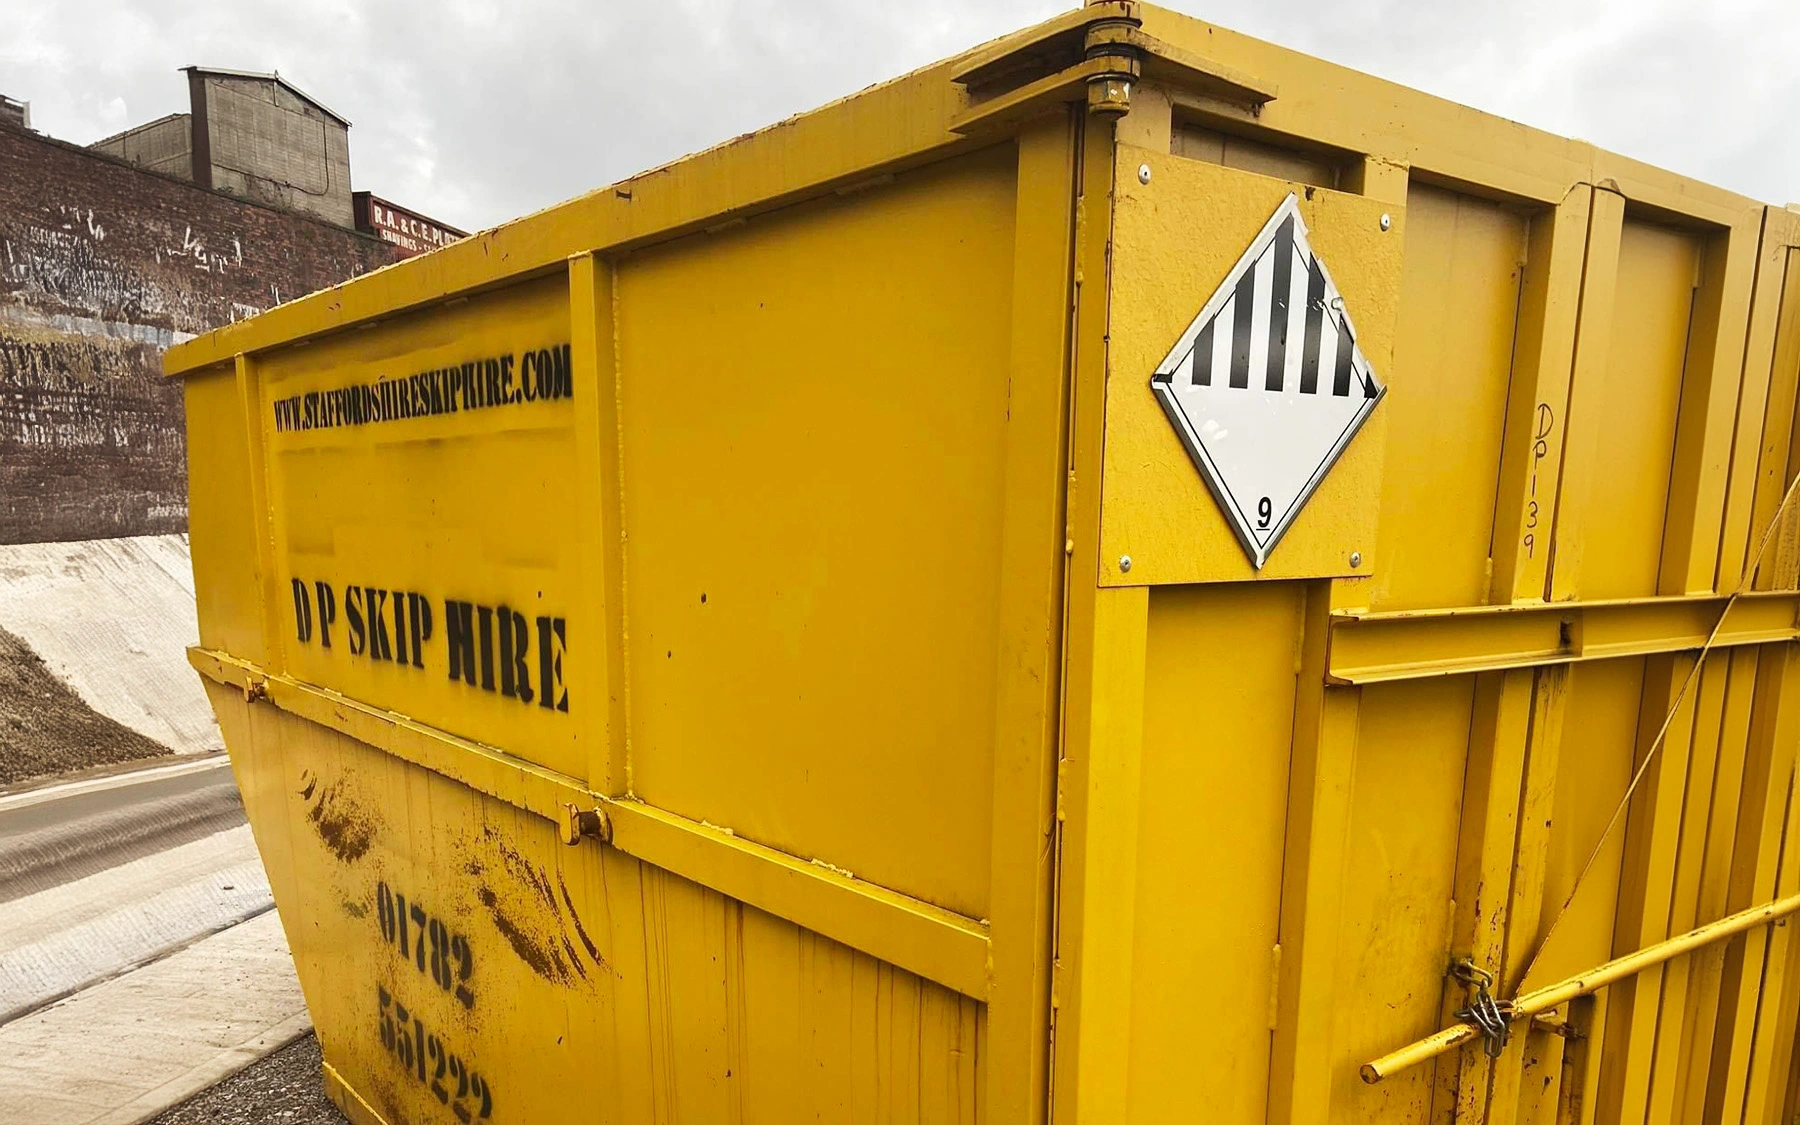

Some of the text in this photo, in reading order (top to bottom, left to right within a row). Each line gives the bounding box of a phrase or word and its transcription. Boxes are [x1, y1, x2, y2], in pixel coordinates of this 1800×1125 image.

[382, 229, 417, 252] SHAVINGS
[400, 218, 409, 233] &
[273, 343, 573, 433] WWW.STAFFORDSHIRESKIPHIRE.COM
[1256, 496, 1272, 530] 9
[345, 584, 433, 669] SKIP
[445, 598, 569, 714] HIRE
[377, 880, 475, 1010] 01782
